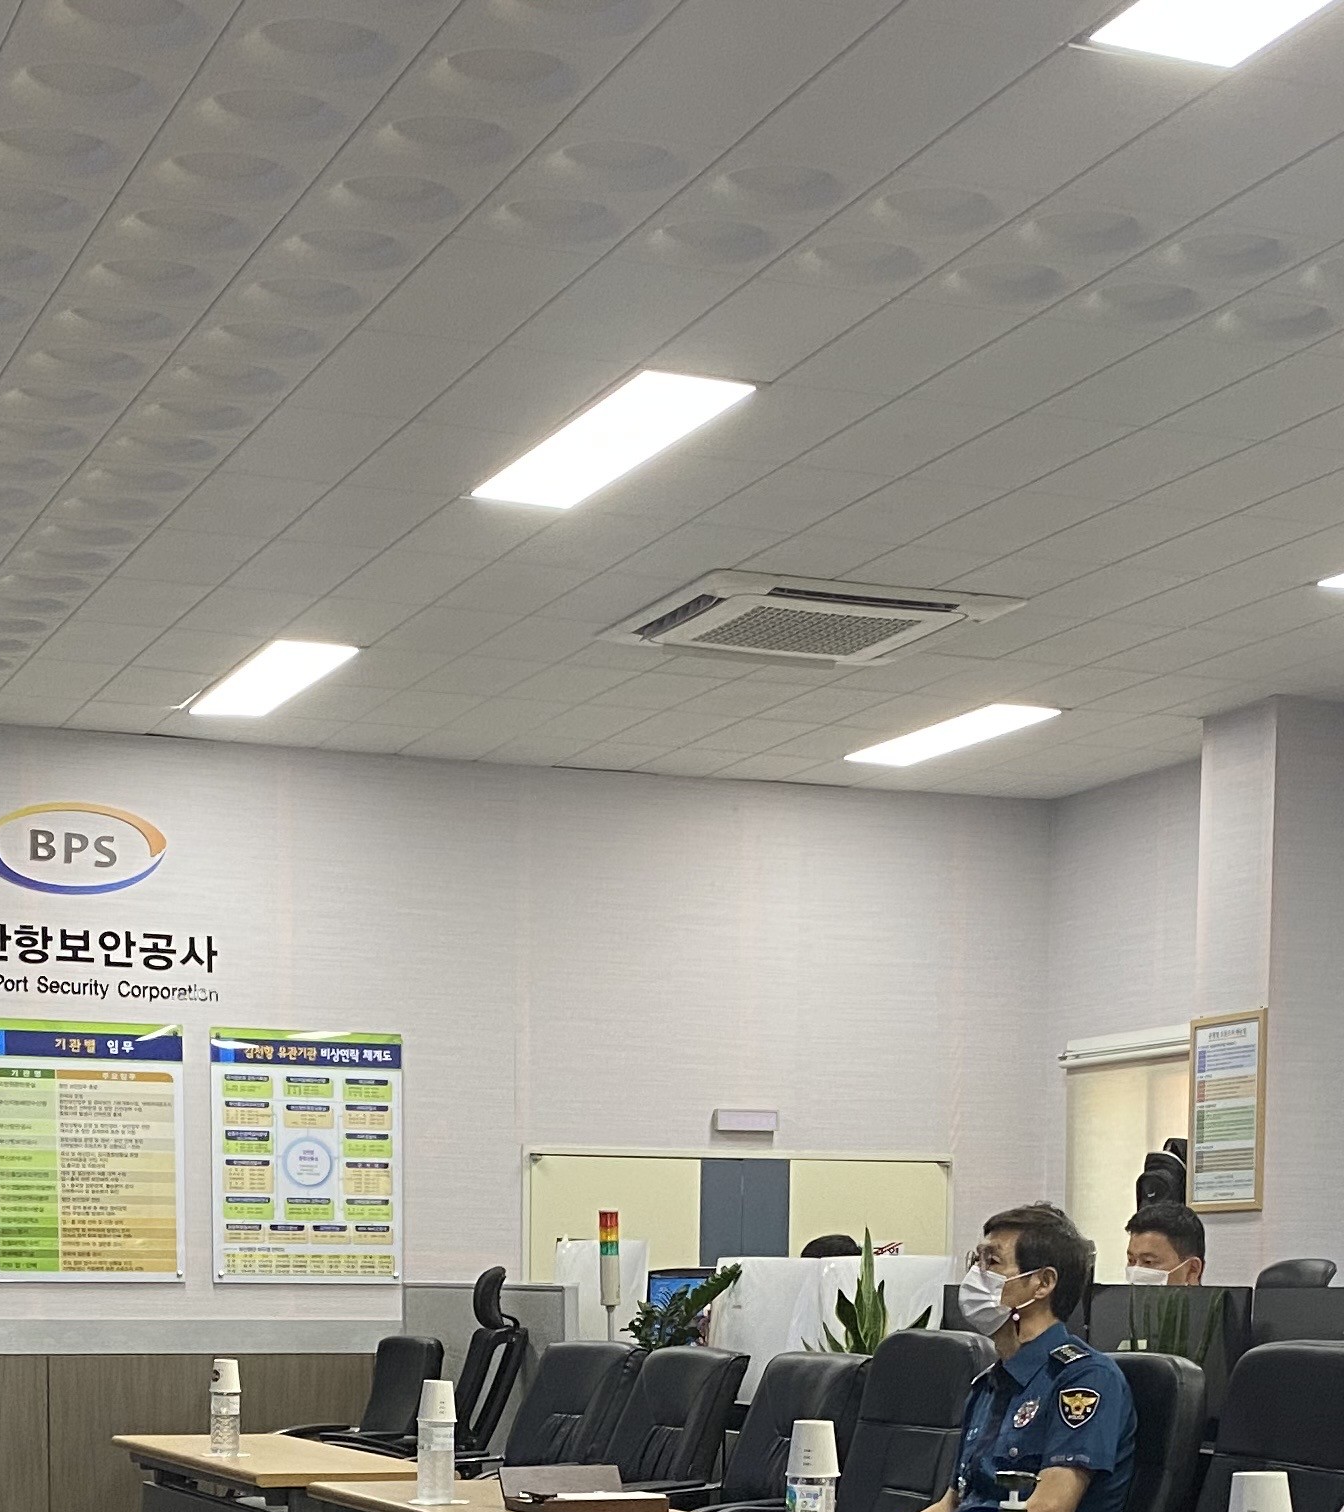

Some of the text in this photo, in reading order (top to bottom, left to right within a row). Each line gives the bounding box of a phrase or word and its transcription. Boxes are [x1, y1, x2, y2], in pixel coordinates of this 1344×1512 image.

[28, 829, 118, 869] BPS
[37, 977, 109, 1000] Security
[117, 980, 218, 1003] Corporation
[55, 1038, 134, 1054] 기관별 임무
[278, 1047, 317, 1060] 유관기관
[320, 1048, 359, 1062] 비상연락
[362, 1050, 392, 1062] 체계도
